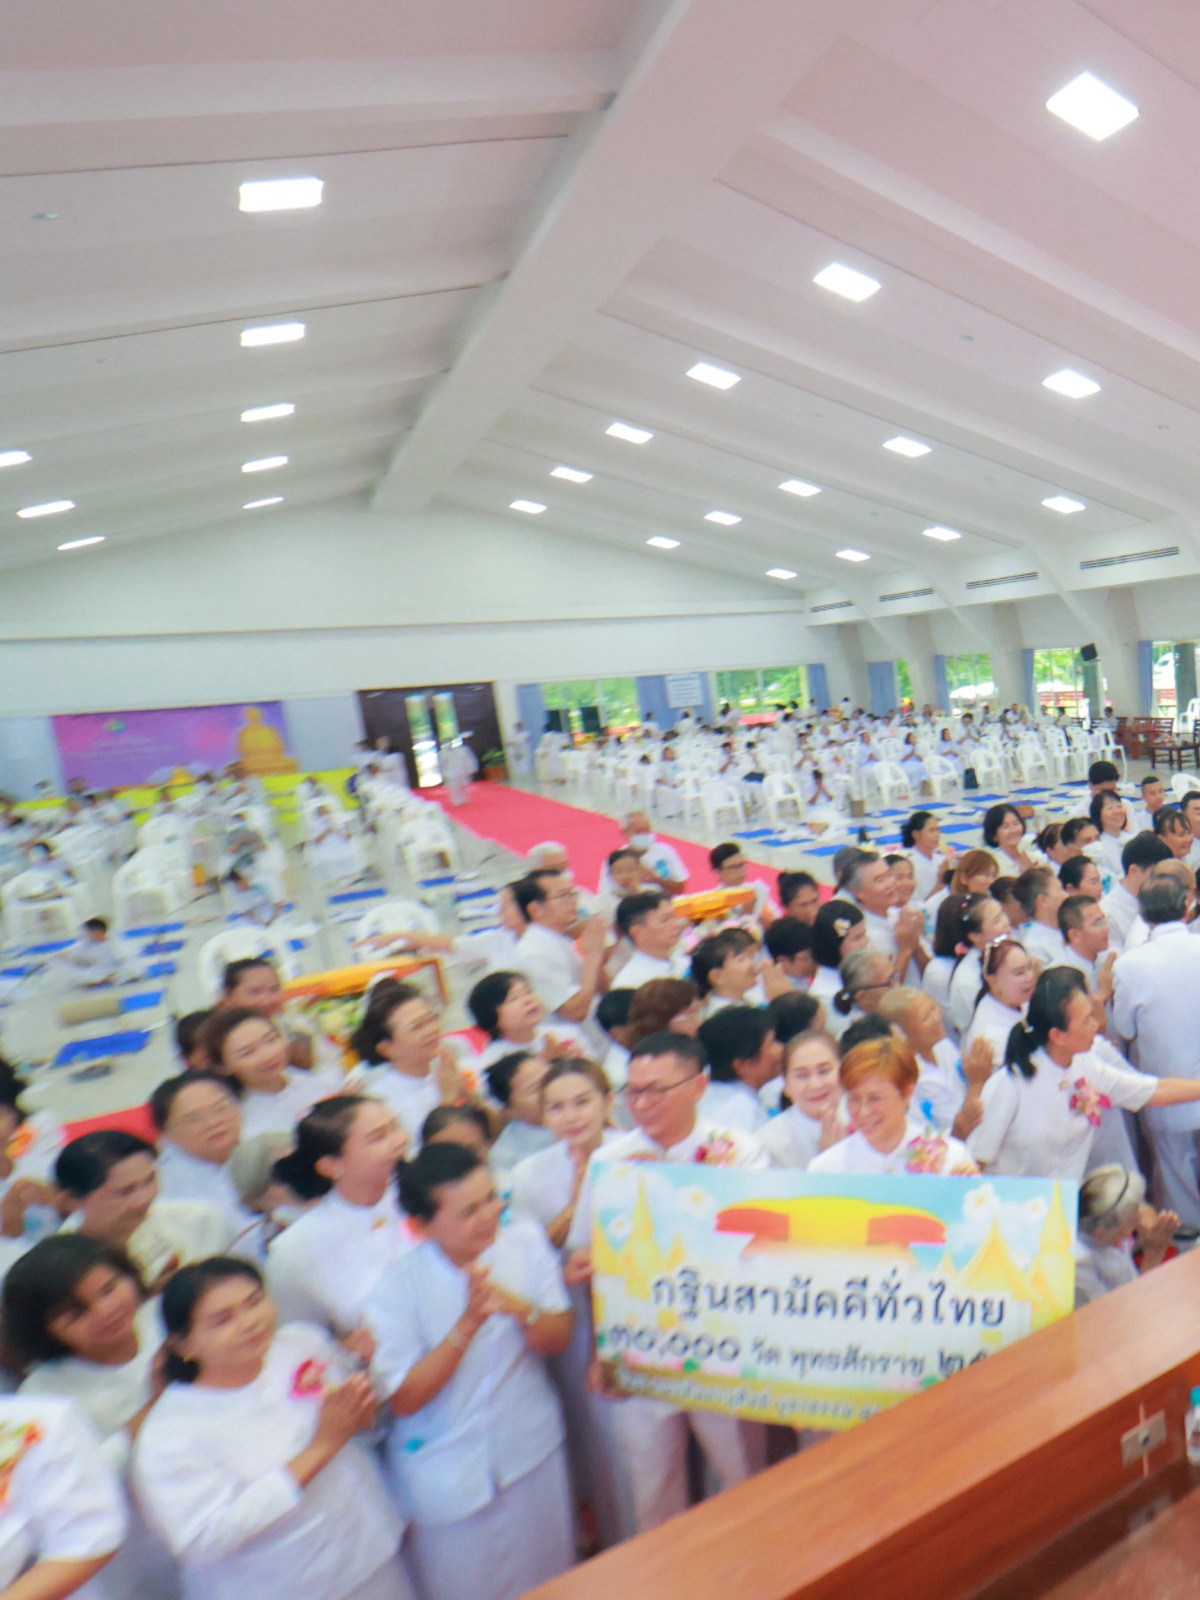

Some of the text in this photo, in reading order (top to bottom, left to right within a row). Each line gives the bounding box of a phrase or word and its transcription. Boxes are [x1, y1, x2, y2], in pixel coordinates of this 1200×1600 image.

[652, 1267, 1005, 1327] กฐินสามัคคีทั่วไทย
